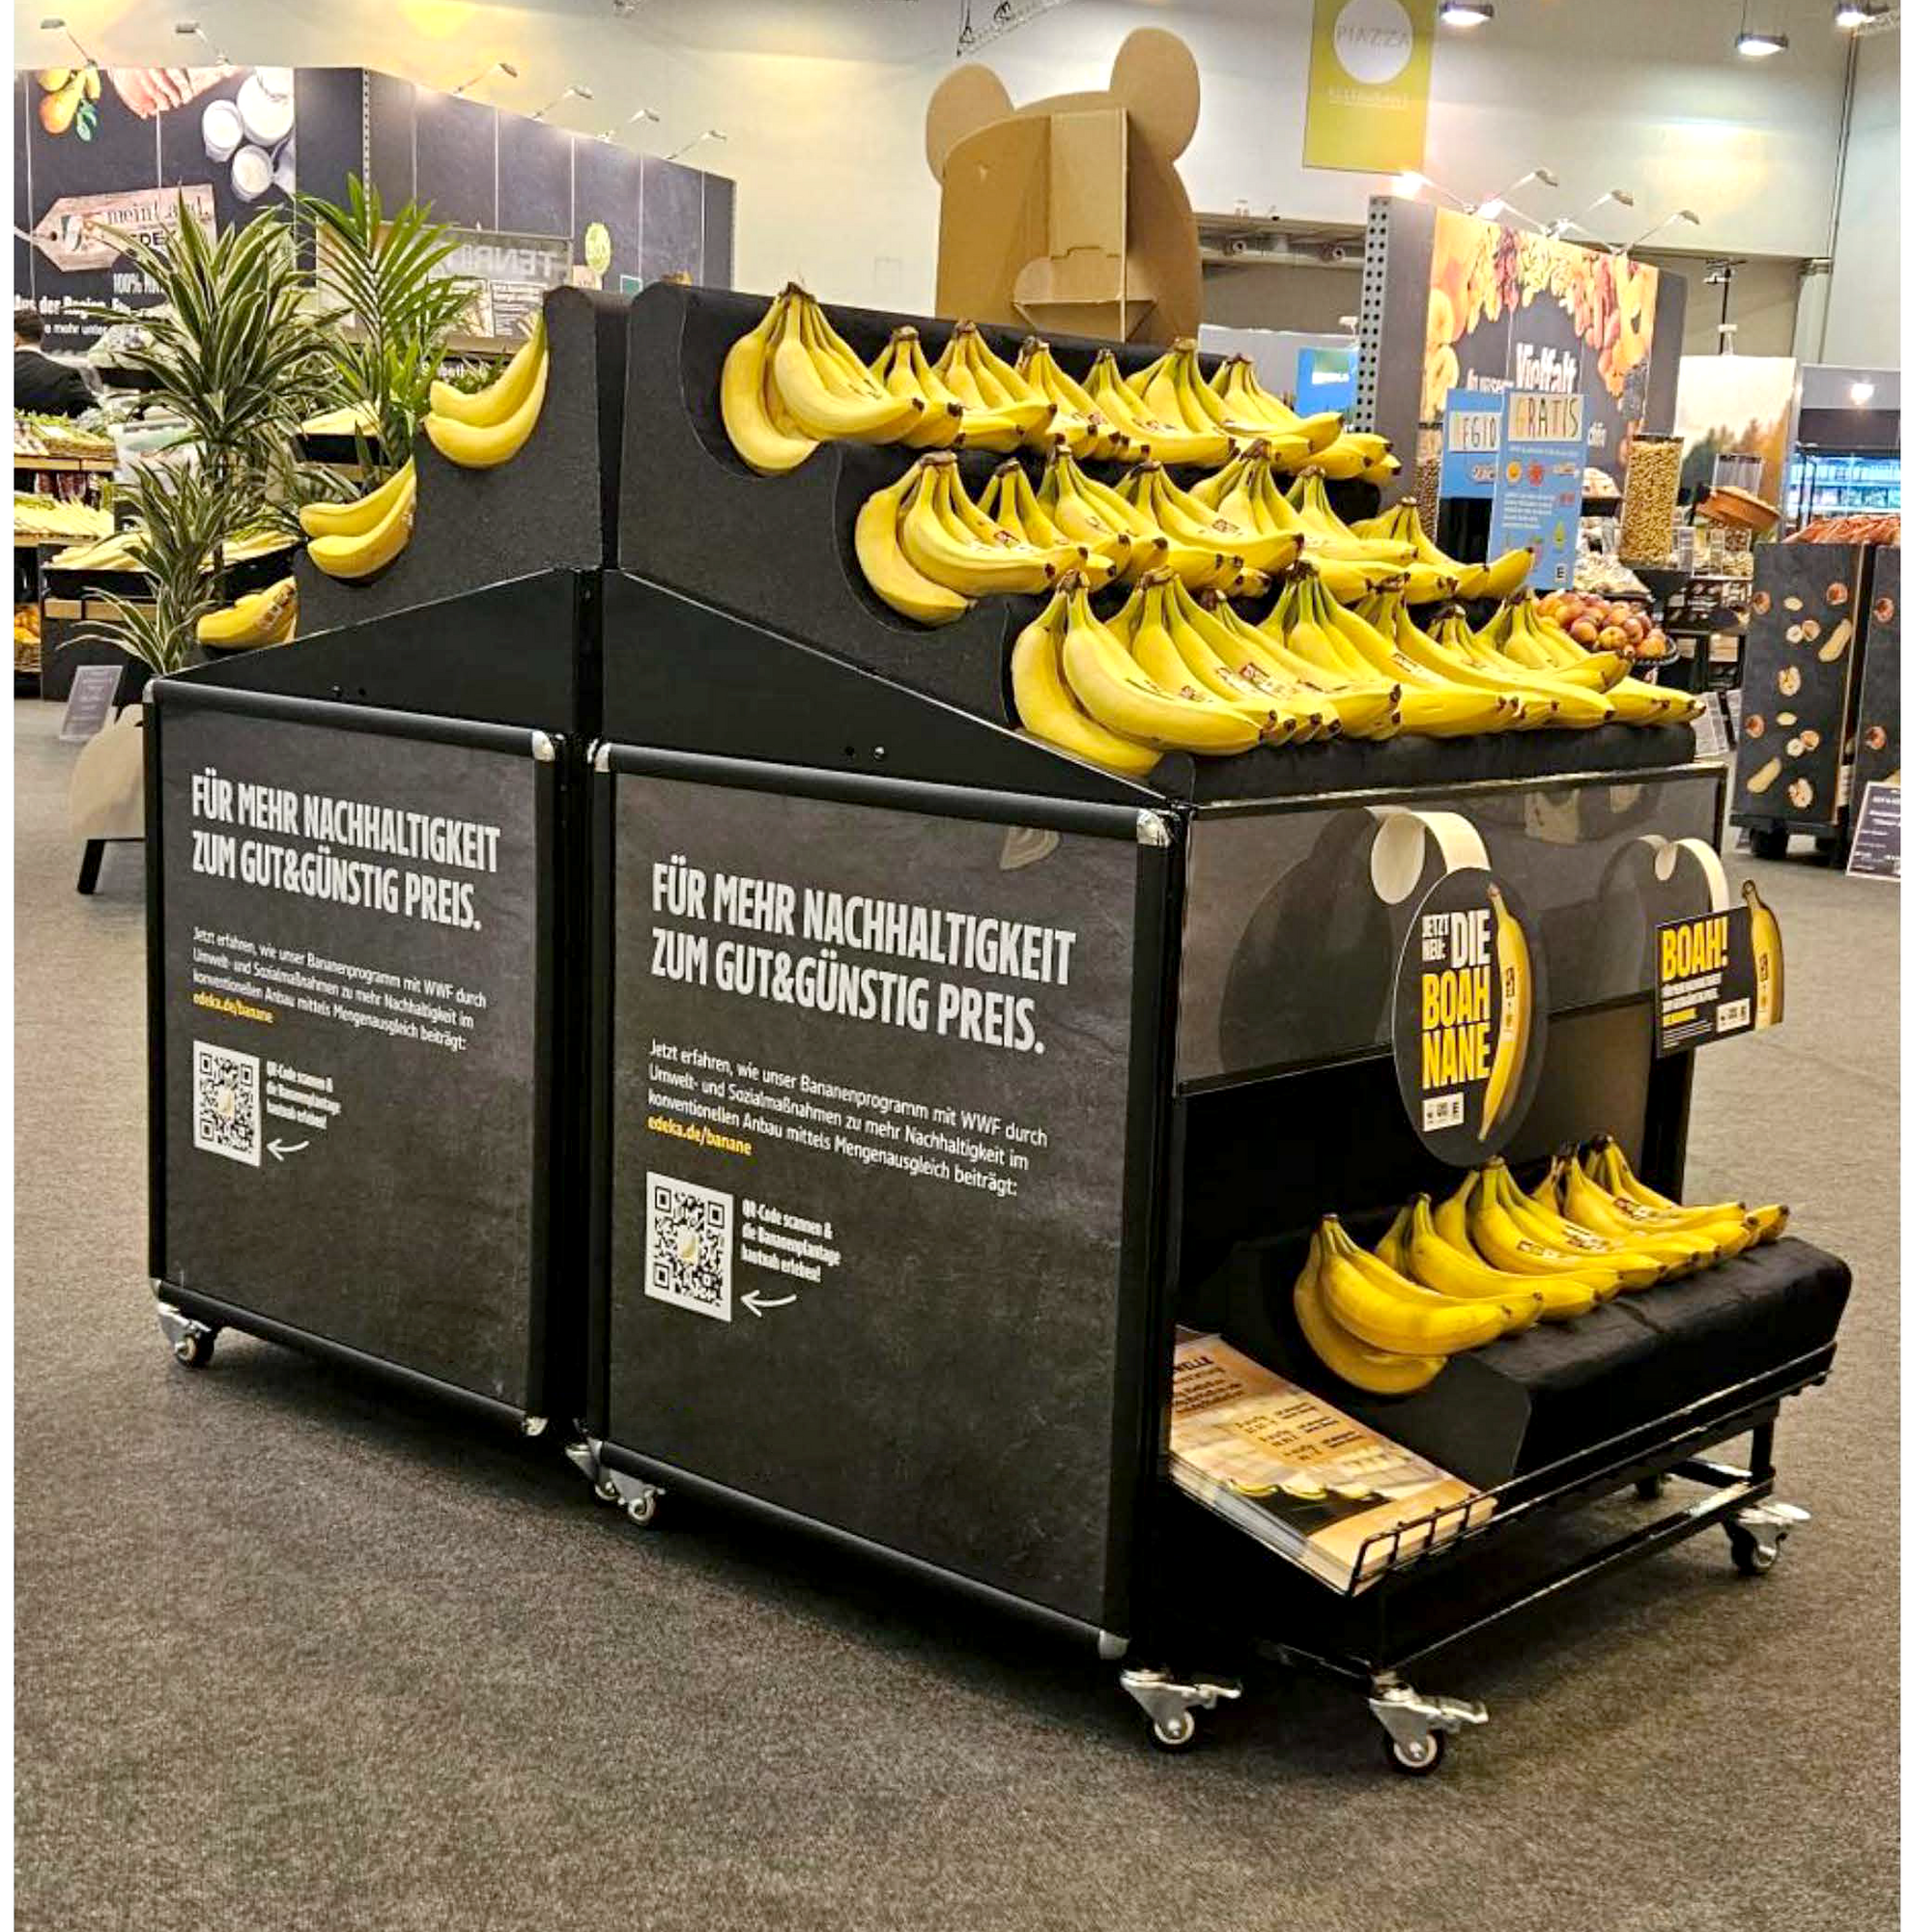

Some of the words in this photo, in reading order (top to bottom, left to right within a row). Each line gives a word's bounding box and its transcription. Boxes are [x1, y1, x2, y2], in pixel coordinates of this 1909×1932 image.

[1516, 342, 1576, 393] Vielfalt
[192, 767, 233, 823] FÜR
[238, 782, 298, 836] MEHR
[303, 794, 500, 872] NACHHALTIGKEIT
[192, 831, 235, 879] ZUM
[241, 840, 398, 914] GUT&GÜNSTIG
[406, 871, 481, 930] PREIS.
[652, 855, 706, 920] FÜR
[714, 872, 796, 935] MEHR
[803, 889, 1077, 985] NACHHALTIGKEIT
[1451, 909, 1491, 969] DIE
[1663, 917, 1728, 981] BOAH!
[193, 927, 214, 945] Jetzt
[216, 933, 257, 955] erfahren,
[259, 943, 276, 958] wie
[279, 948, 305, 965] unser
[307, 952, 400, 986] Bananenprogramm
[404, 978, 420, 993] mit
[424, 980, 453, 1000] WWF
[456, 987, 486, 1009] durch
[234, 957, 251, 974] und
[356, 988, 381, 1006] mehr
[385, 993, 457, 1026] Nachhaltigkeit
[460, 1012, 473, 1029] im
[651, 927, 708, 985] ZUM
[715, 941, 928, 1032] GUT&GÜNSTIG
[937, 983, 1045, 1055] PREIS.
[1422, 966, 1491, 1030] BOAH
[265, 987, 295, 1008] Anbau
[298, 996, 330, 1016] mittels
[332, 1005, 418, 1038] Mengenausgleich
[420, 1025, 466, 1052] beiträgt:
[1422, 1021, 1491, 1090] NANE
[649, 1064, 698, 1091] Umwelt-
[701, 1076, 725, 1096] und
[728, 1083, 841, 1125] Sozialmaßnahmen
[845, 1115, 862, 1131] zu
[865, 1118, 901, 1141] mehr
[904, 1124, 1005, 1169] Nachhaltigkeit
[1010, 1149, 1030, 1171] im
[650, 1038, 677, 1063] Jetzt
[680, 1048, 733, 1076] erfahren,
[737, 1062, 759, 1082] wie
[763, 1069, 798, 1090] unser
[800, 1075, 928, 1122] Bananenprogramm
[932, 1105, 956, 1125] mit
[961, 1111, 1002, 1136] WWF
[1006, 1122, 1048, 1148] durch
[647, 1116, 753, 1157] edeka.de/banane
[647, 1088, 740, 1129] konventionellen
[743, 1111, 783, 1138] Anbau
[787, 1123, 831, 1151] mittels
[835, 1131, 950, 1180] Mengenausgleich
[954, 1164, 1018, 1198] beiträgt:
